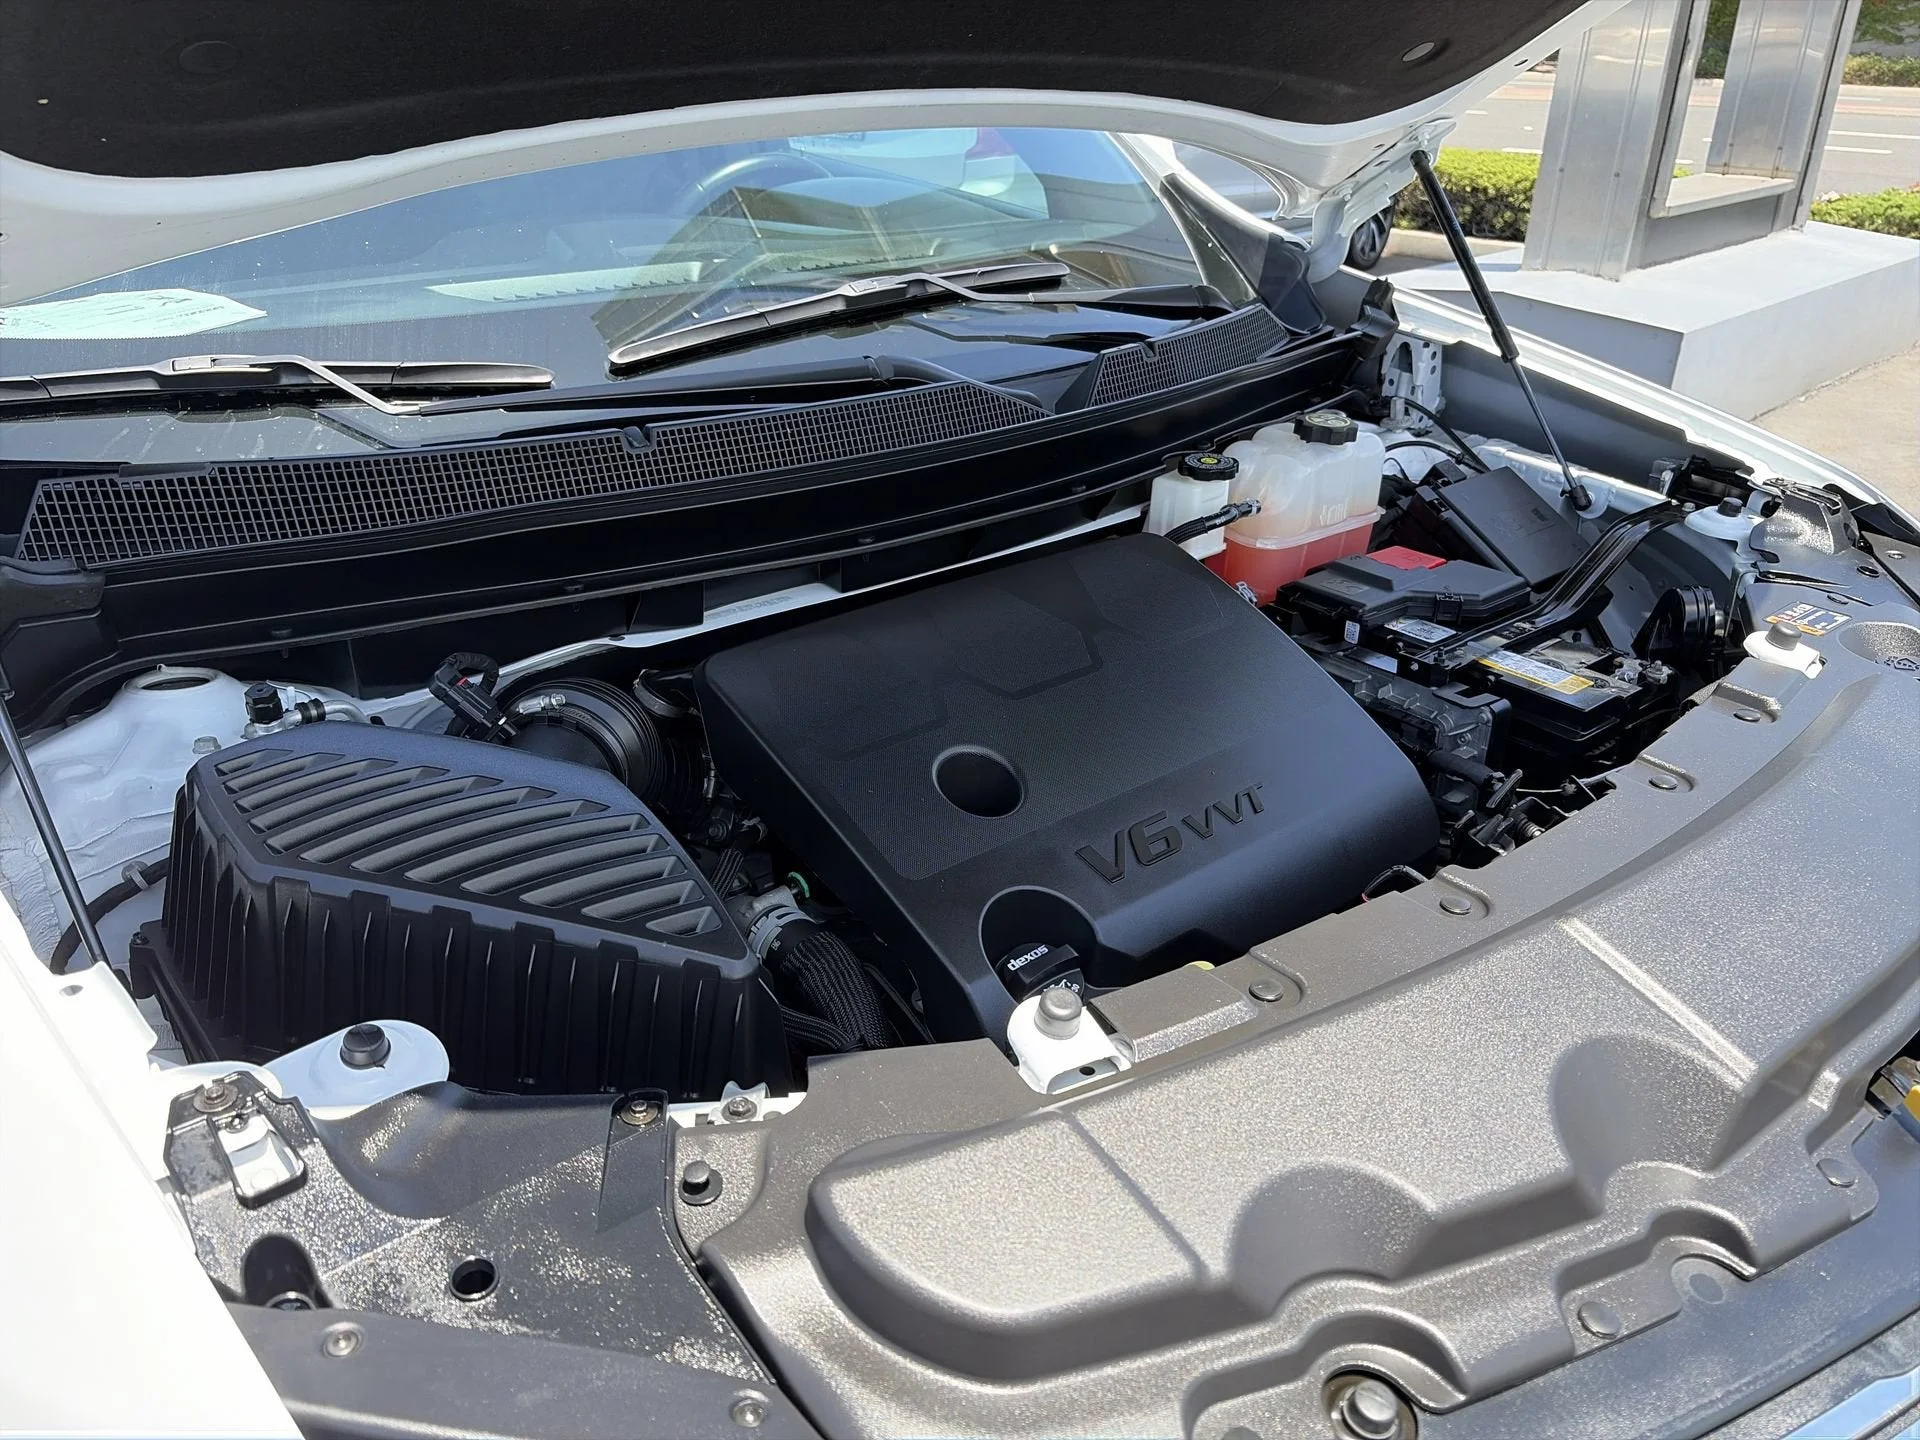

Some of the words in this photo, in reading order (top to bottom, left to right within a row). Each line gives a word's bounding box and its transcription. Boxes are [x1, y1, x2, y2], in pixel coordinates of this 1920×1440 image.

[1075, 810, 1183, 884] V6
[1181, 783, 1264, 840] VVT
[1007, 944, 1049, 971] dexos
